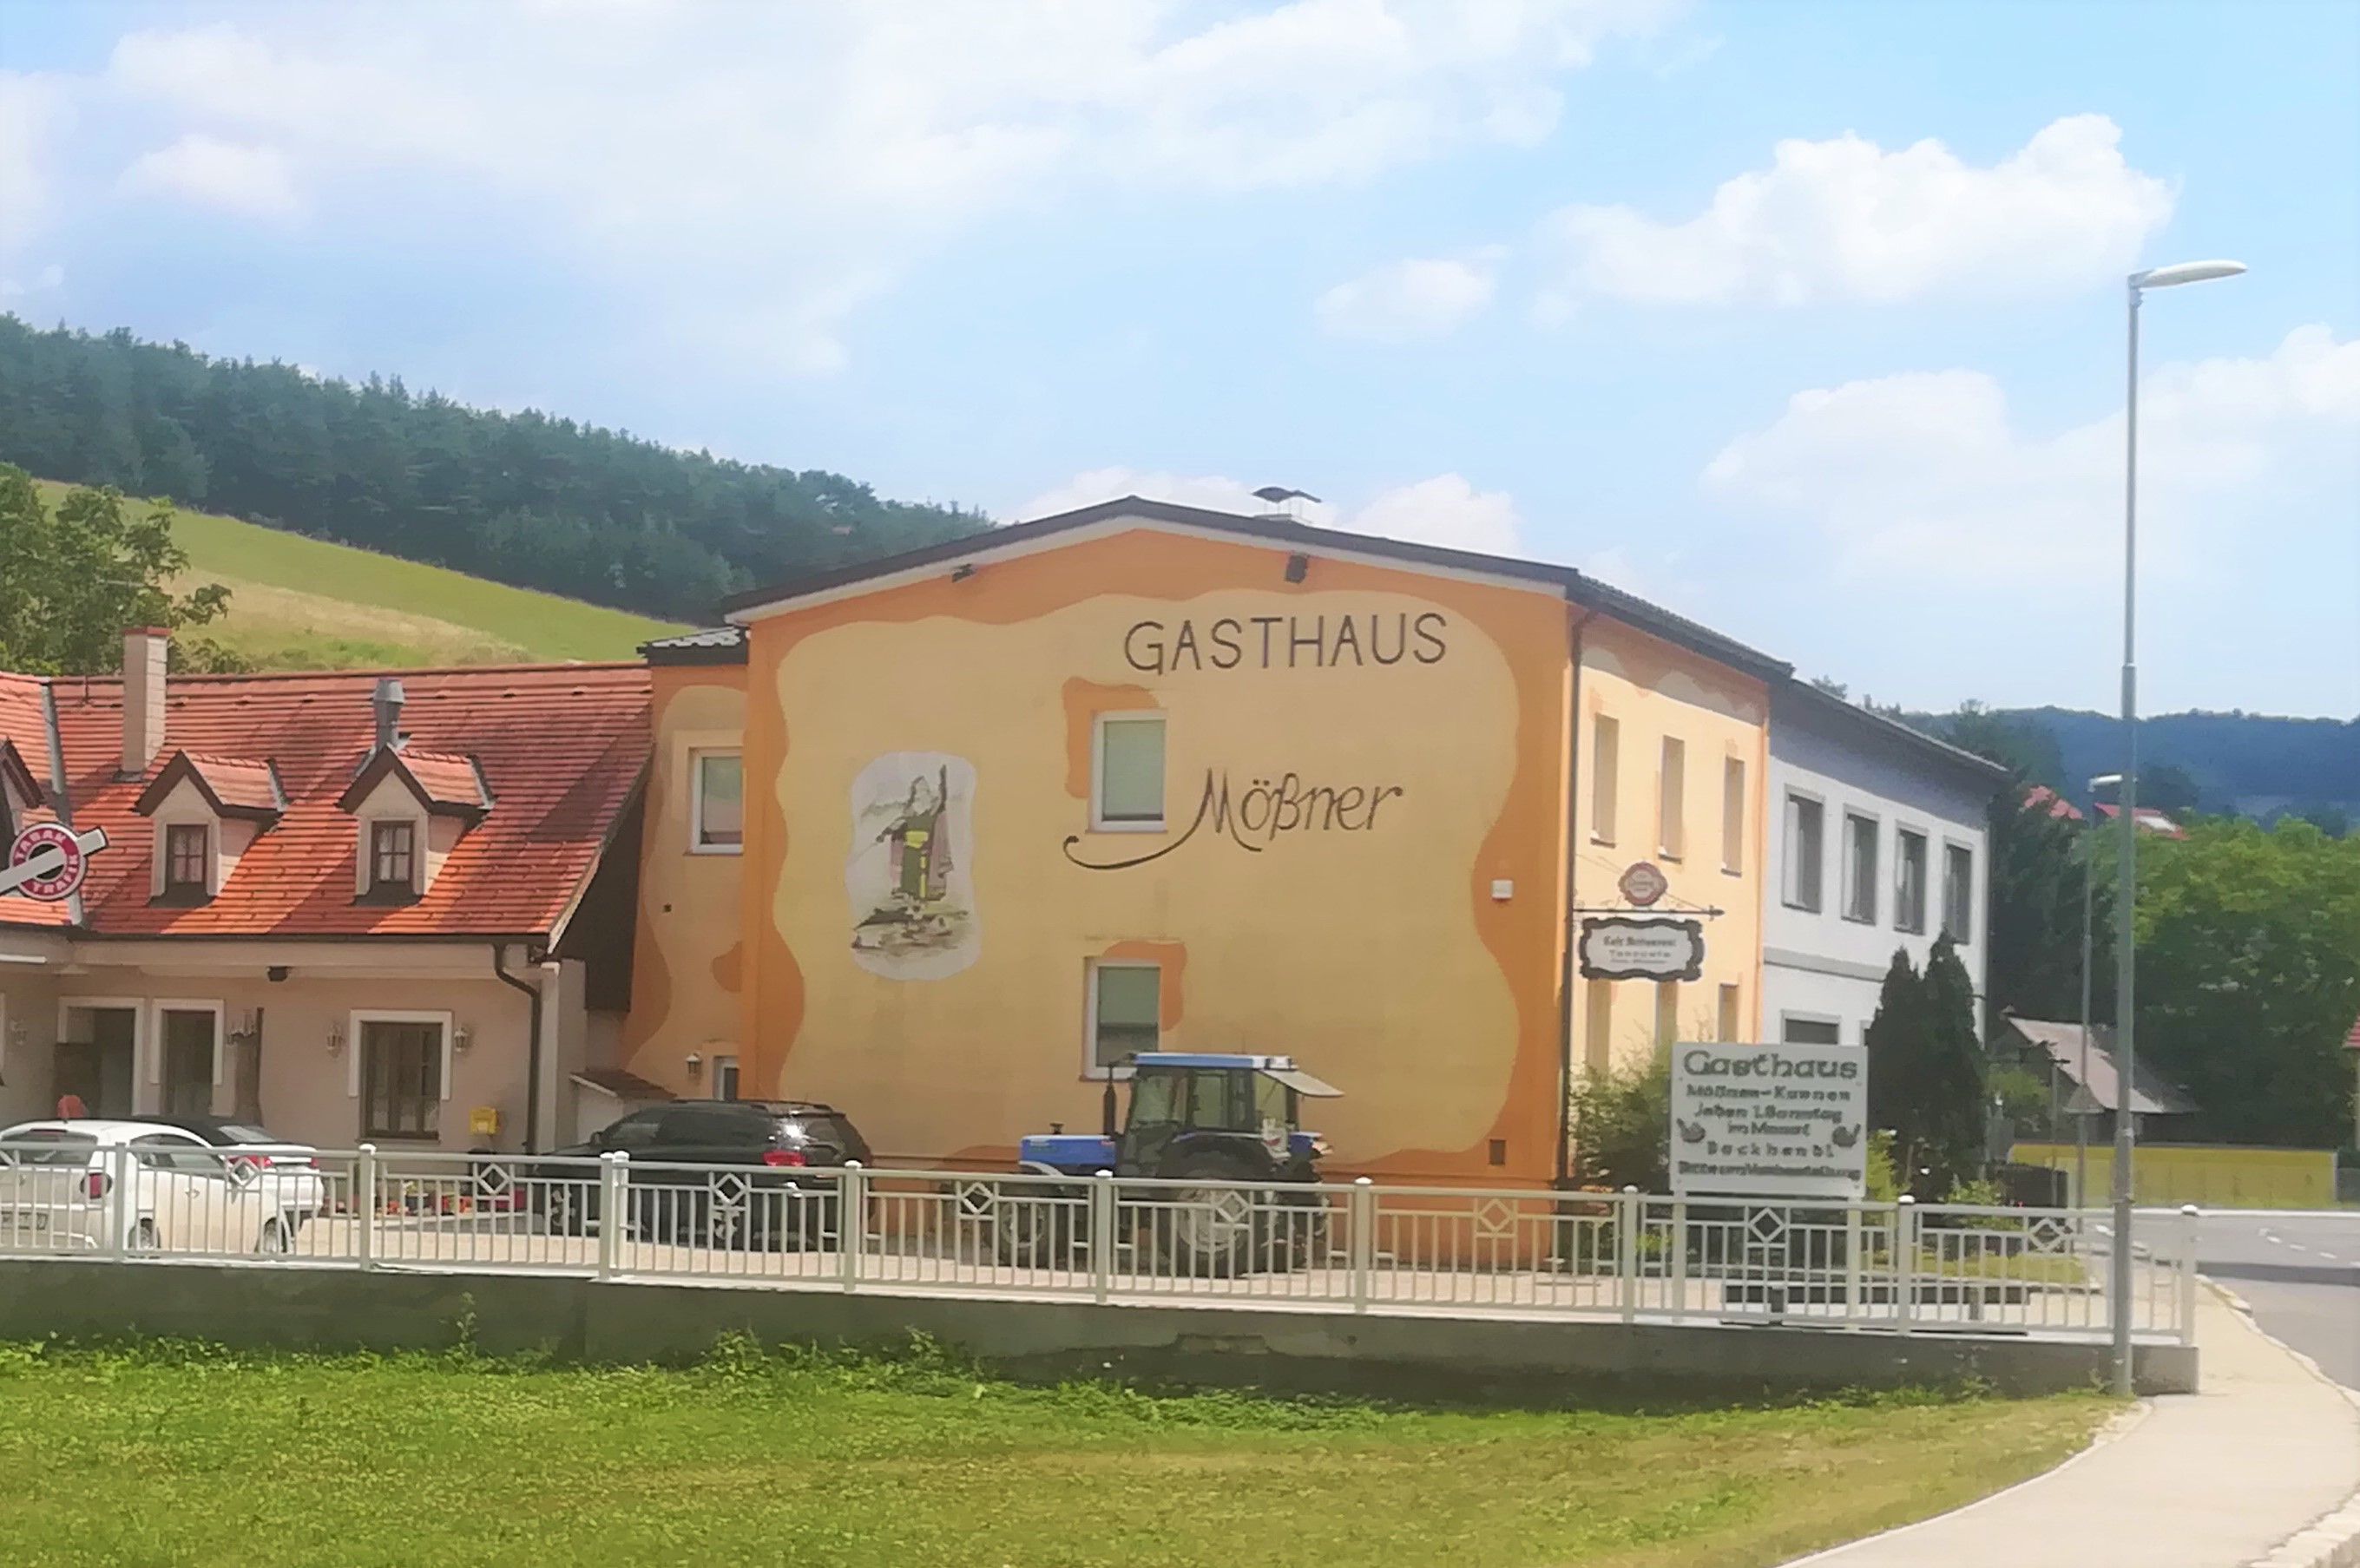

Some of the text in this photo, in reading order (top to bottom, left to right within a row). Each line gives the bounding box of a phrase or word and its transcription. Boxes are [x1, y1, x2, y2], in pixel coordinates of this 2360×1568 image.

[1125, 613, 1447, 675] GASTHAUS
[1063, 768, 1404, 869] Mößner
[15, 830, 67, 858] TABAK
[31, 854, 79, 894] TRAFIK
[1683, 1050, 1858, 1079] Gasthaus
